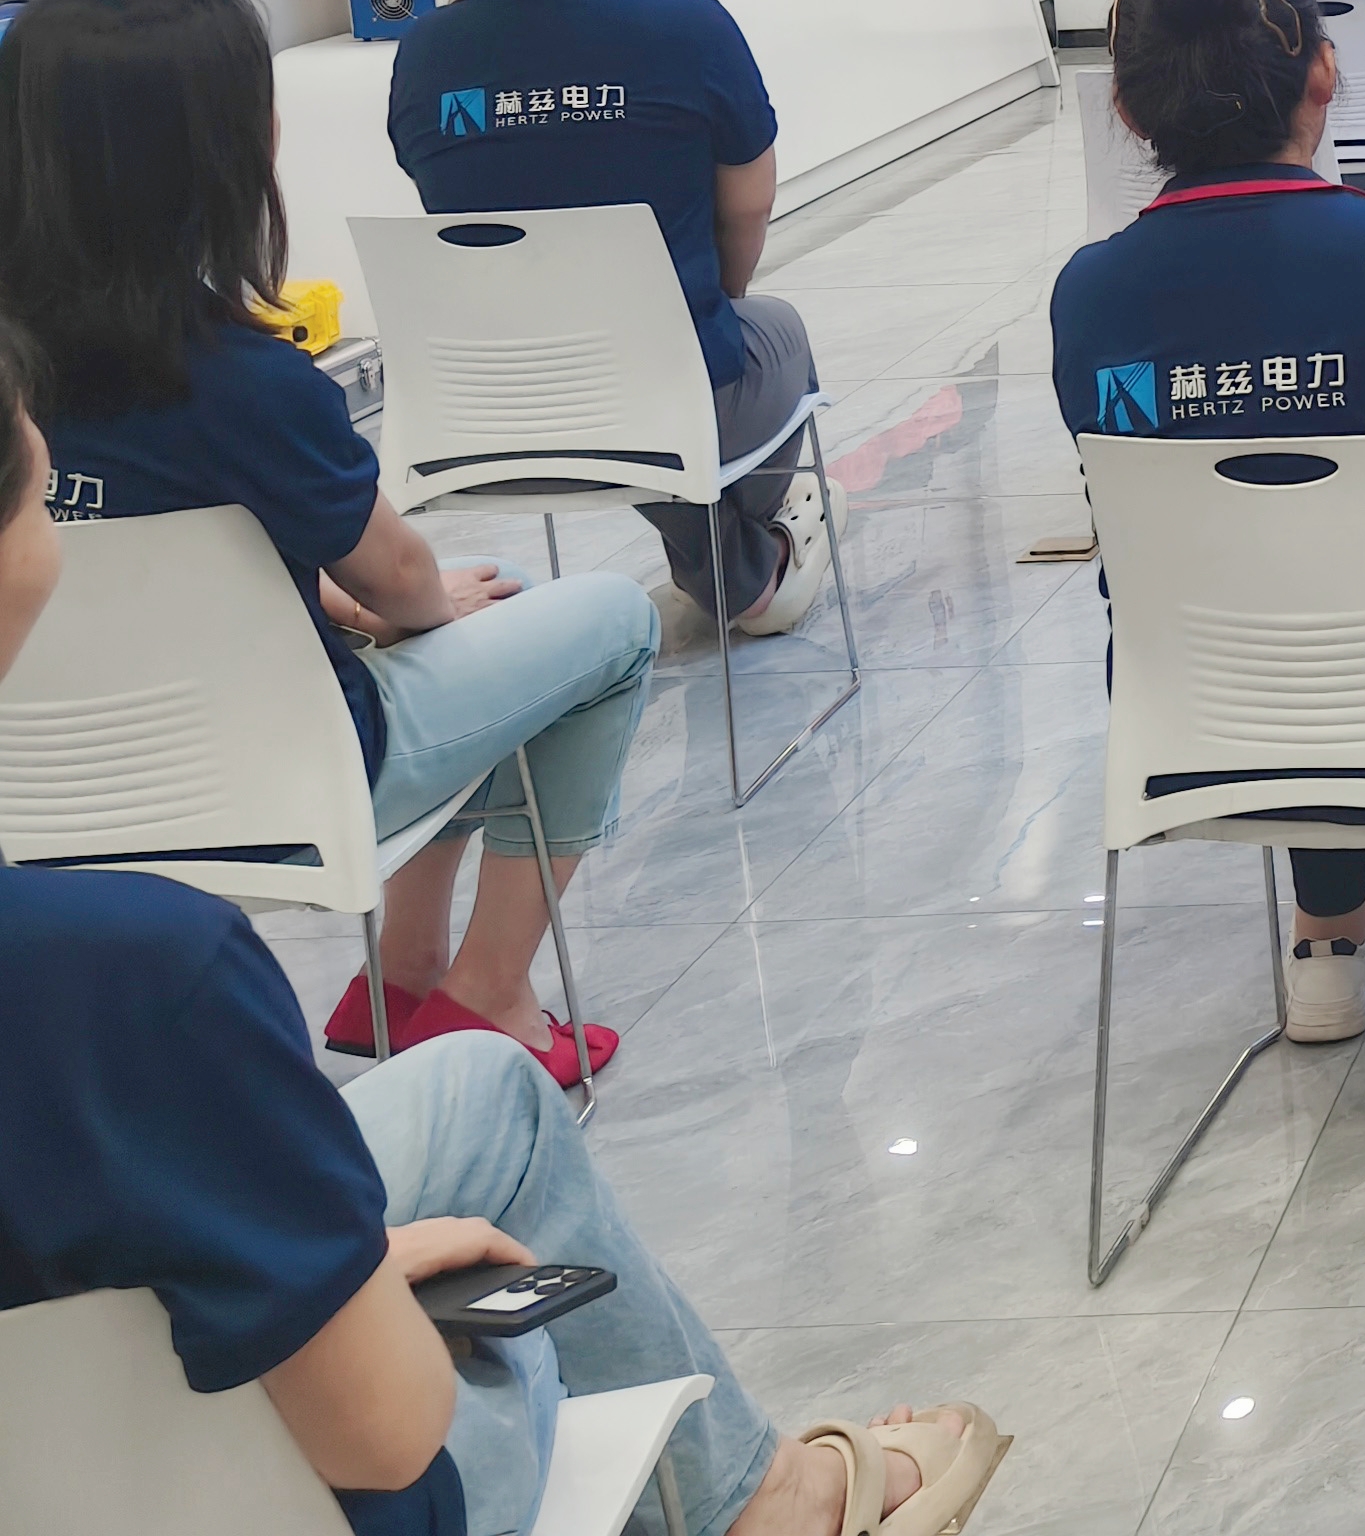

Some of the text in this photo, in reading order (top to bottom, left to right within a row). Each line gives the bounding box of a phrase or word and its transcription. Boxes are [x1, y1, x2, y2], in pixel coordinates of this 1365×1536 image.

[495, 84, 626, 115] 赫兹电力
[495, 109, 626, 128] HERTZ POWER
[1169, 352, 1345, 401] 赫兹电力
[1171, 392, 1346, 420] HERTZ POWER
